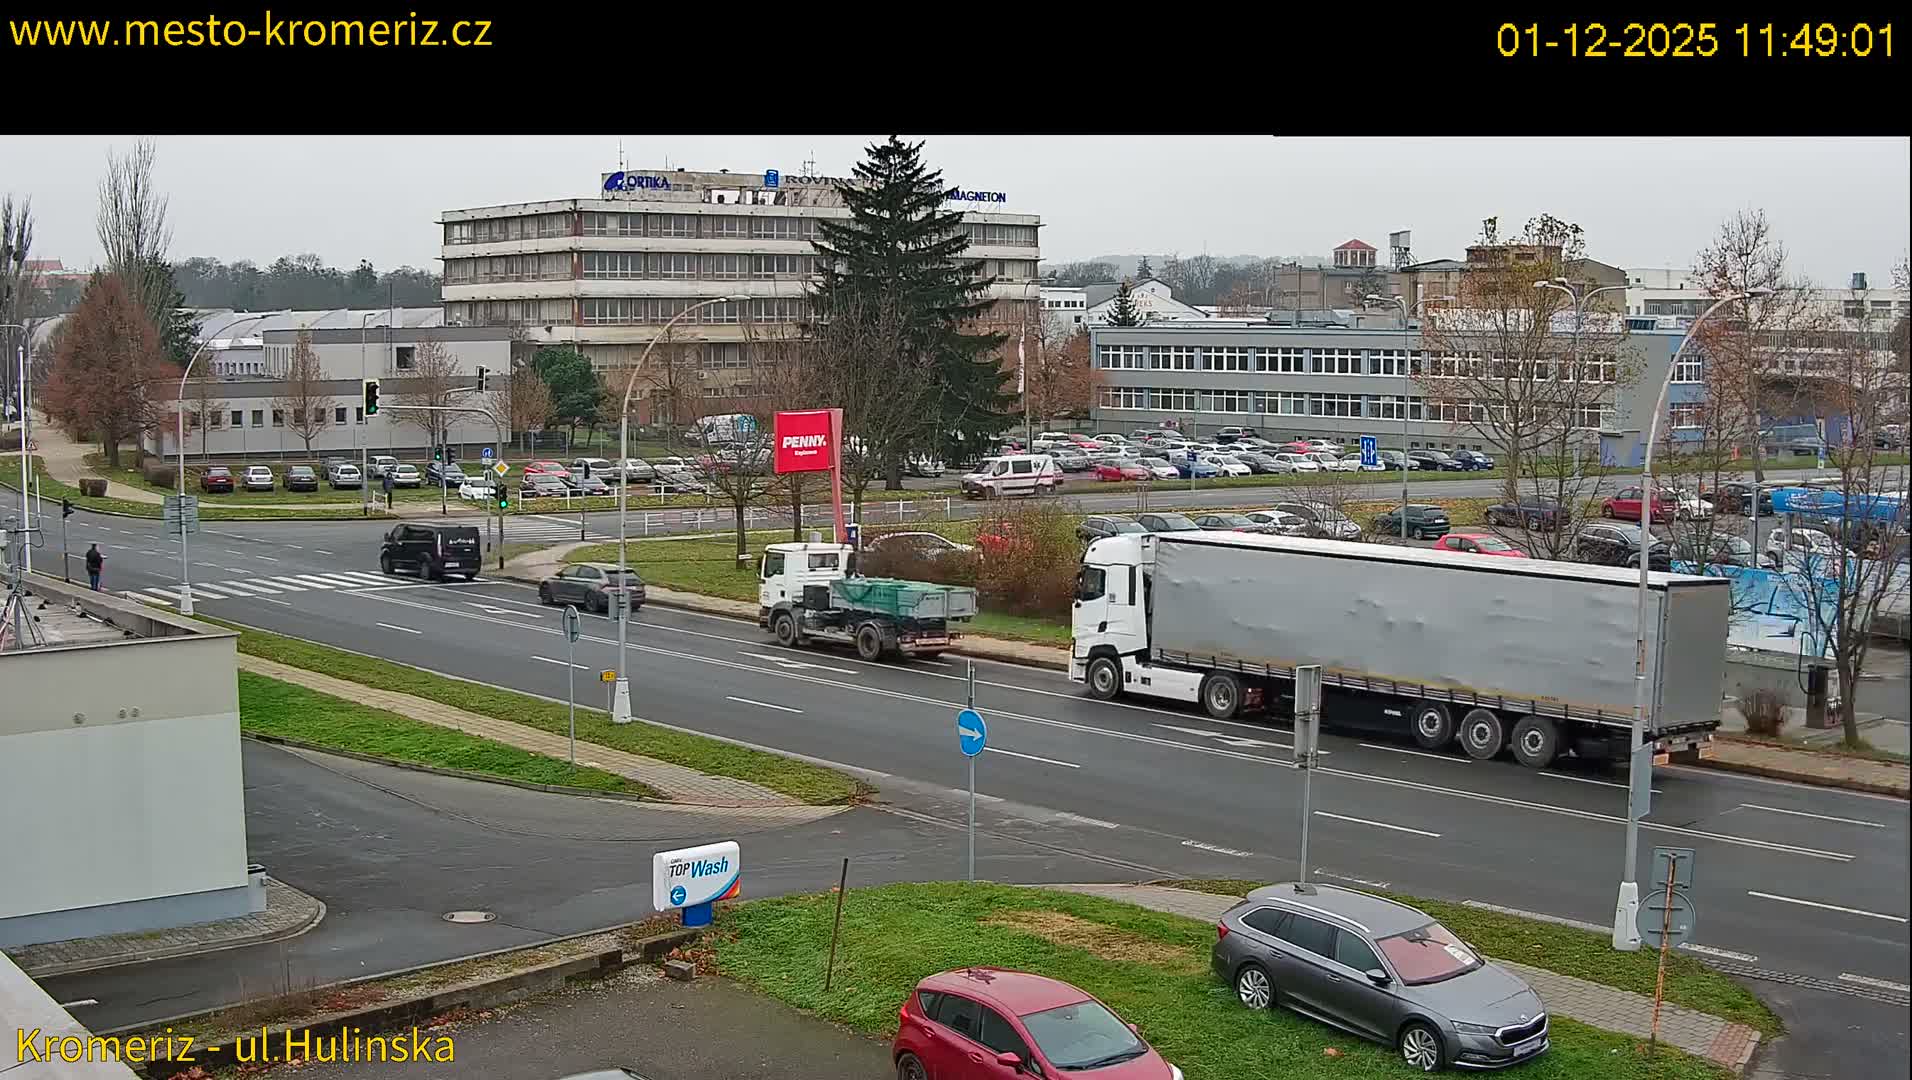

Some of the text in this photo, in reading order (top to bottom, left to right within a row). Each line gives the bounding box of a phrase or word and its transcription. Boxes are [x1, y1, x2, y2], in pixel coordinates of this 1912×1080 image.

[627, 175, 671, 189] ORTIKA
[670, 856, 729, 878] TOP Wash
